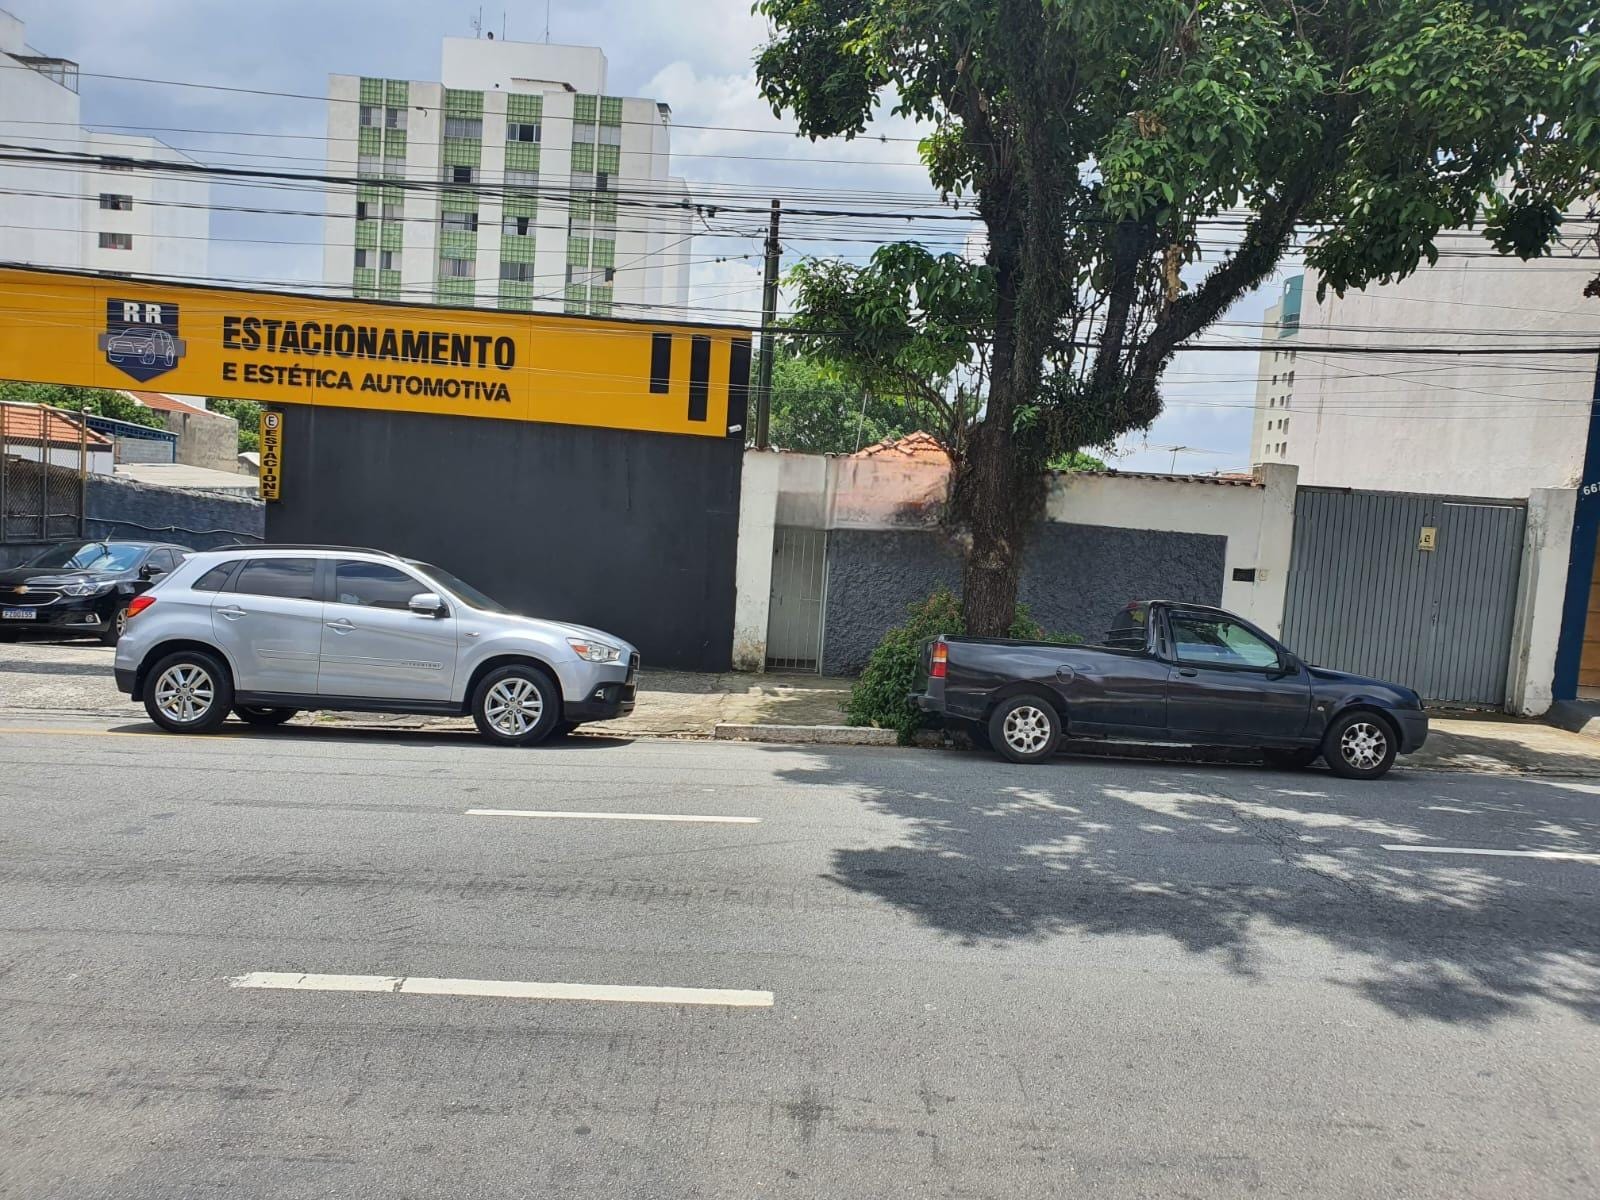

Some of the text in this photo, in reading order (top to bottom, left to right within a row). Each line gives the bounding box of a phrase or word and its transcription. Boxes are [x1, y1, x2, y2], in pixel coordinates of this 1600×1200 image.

[223, 315, 516, 371] ESTACIONAMENTO
[222, 362, 512, 402] E ESTÉTICA AUTOMOTIVA
[263, 429, 278, 497] ESTACIONE
